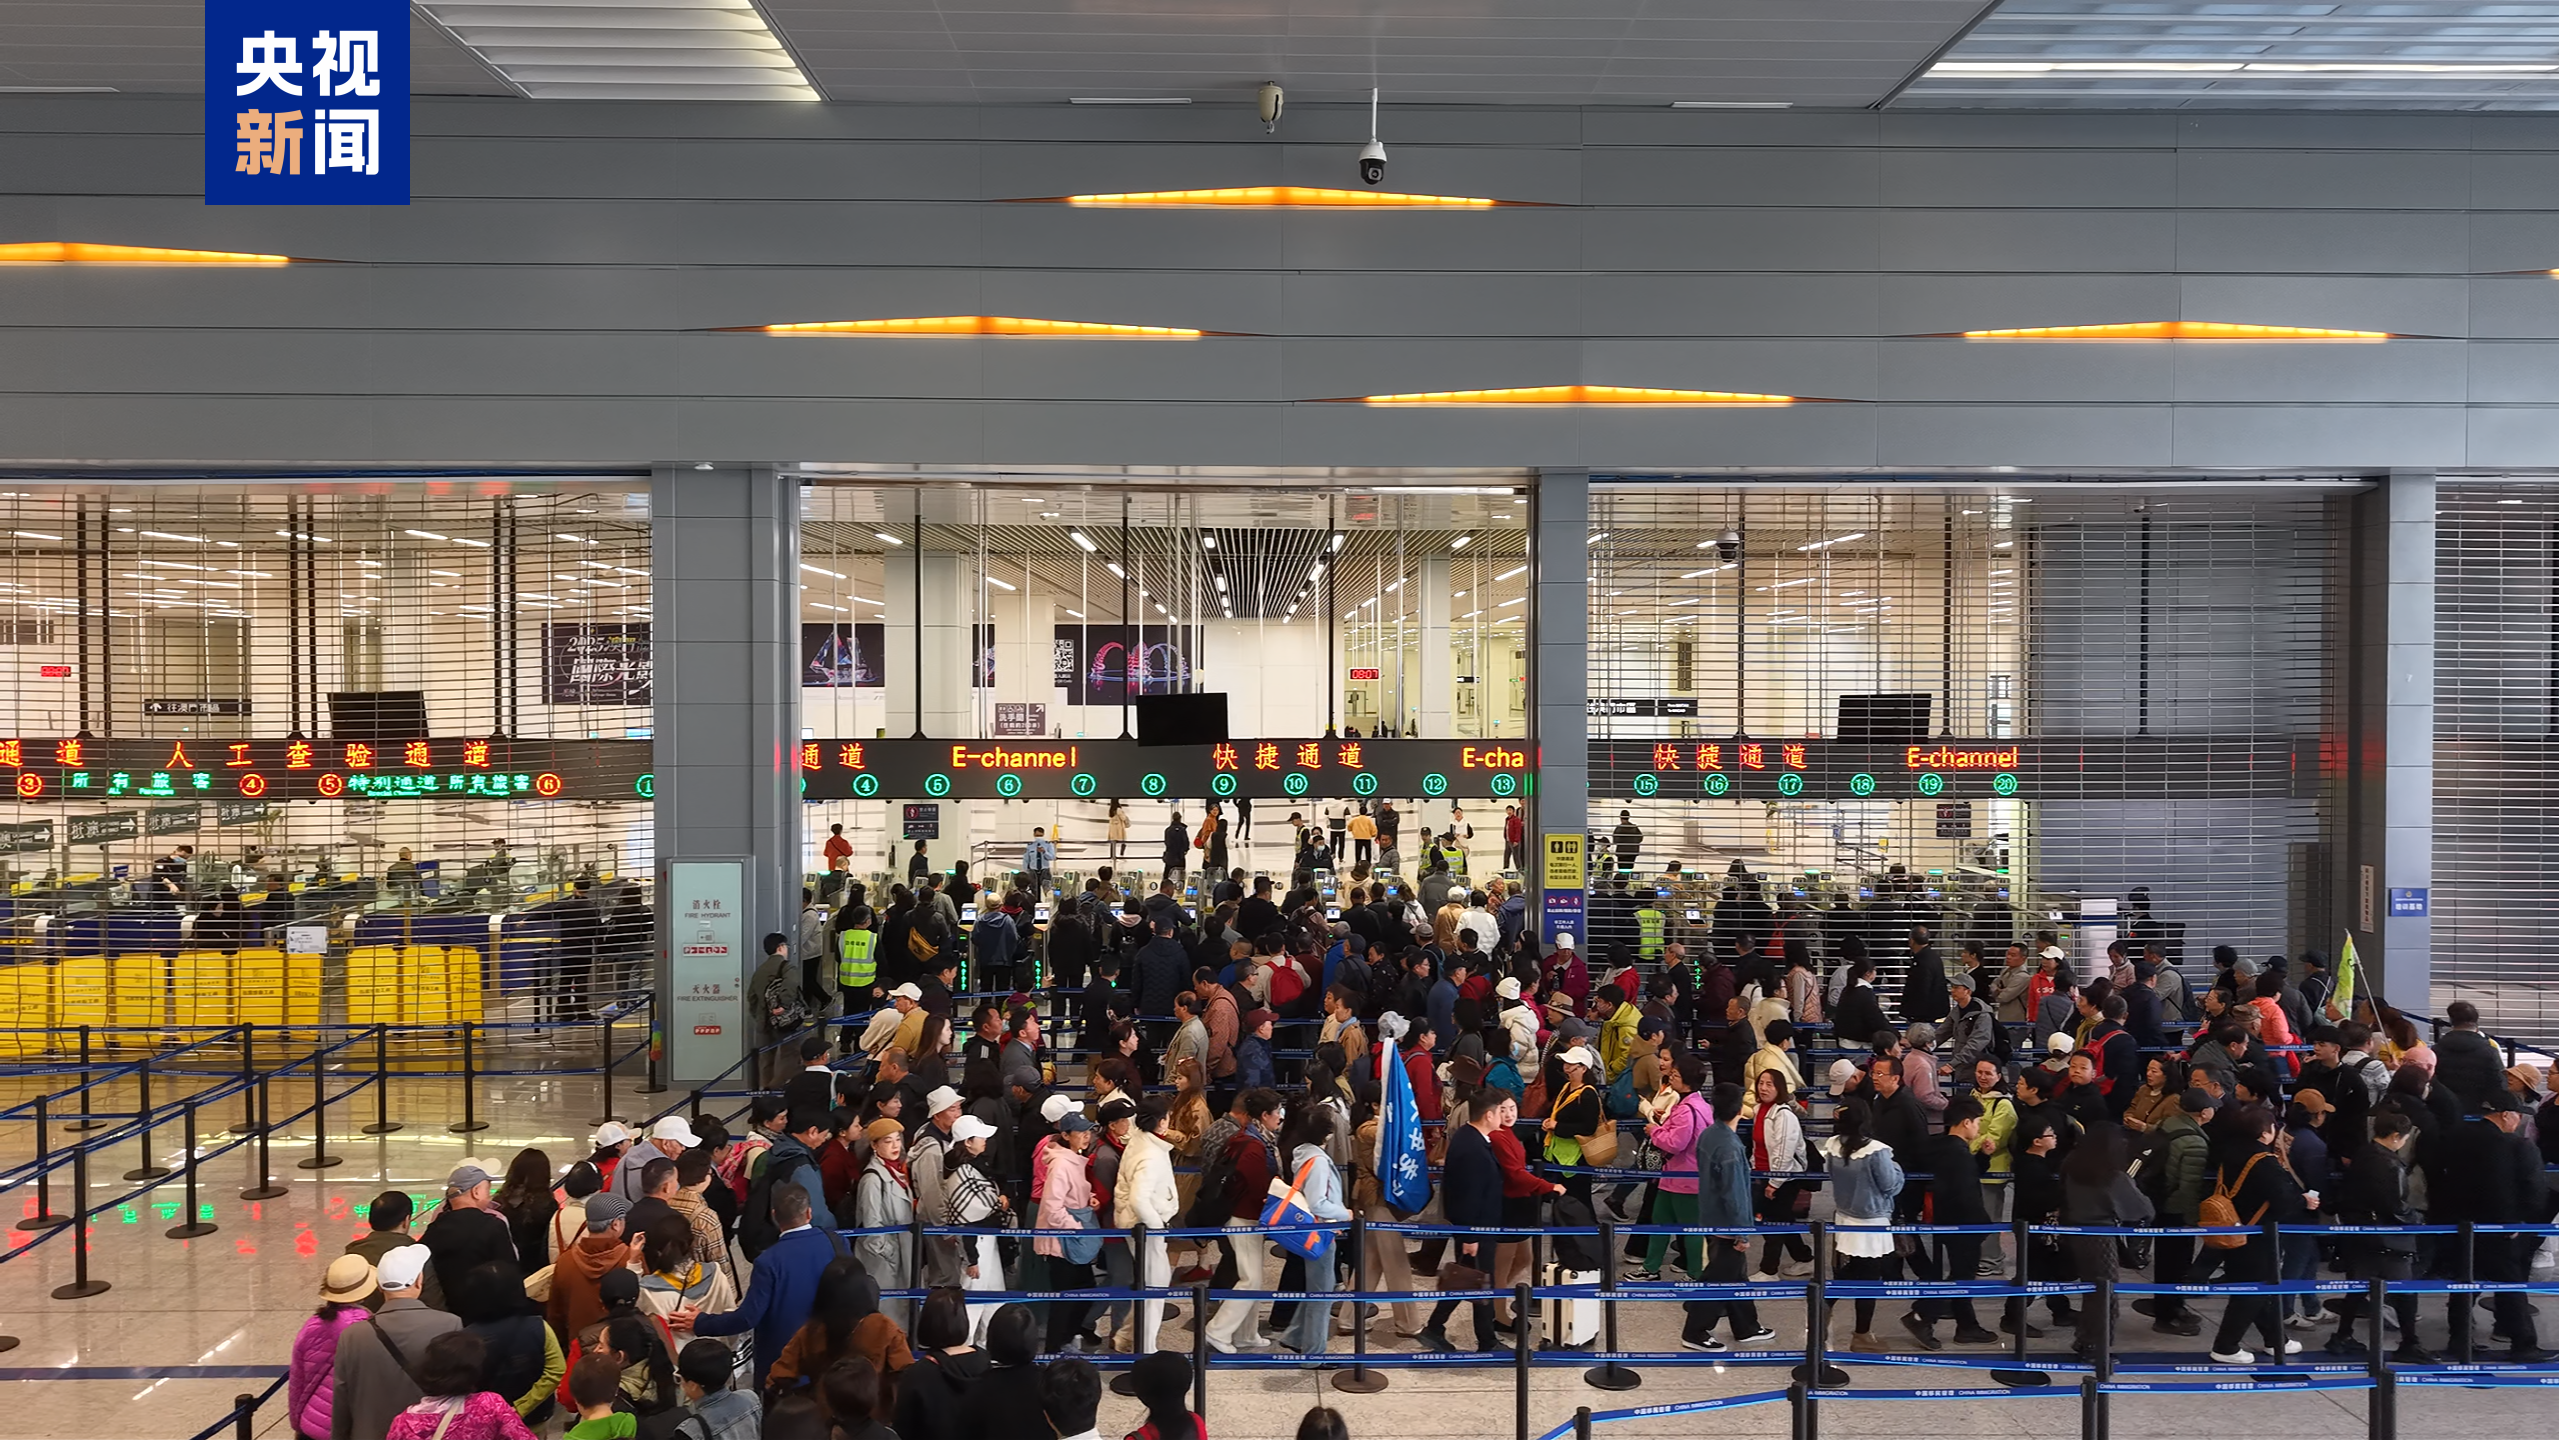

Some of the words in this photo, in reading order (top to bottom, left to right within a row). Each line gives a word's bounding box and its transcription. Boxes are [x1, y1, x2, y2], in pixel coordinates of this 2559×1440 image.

[165, 741, 490, 768] 人工查验通道
[952, 746, 1077, 769] E-channel
[1212, 743, 1364, 770] 快捷通道
[1654, 743, 1808, 770] 快捷通道
[1907, 746, 2018, 769] E-channel
[72, 772, 210, 789] 所有旅客
[348, 774, 439, 790] 特别通道
[449, 774, 530, 791] 所有旅客
[692, 899, 721, 910] 消火栓
[692, 984, 720, 994] 灭火器
